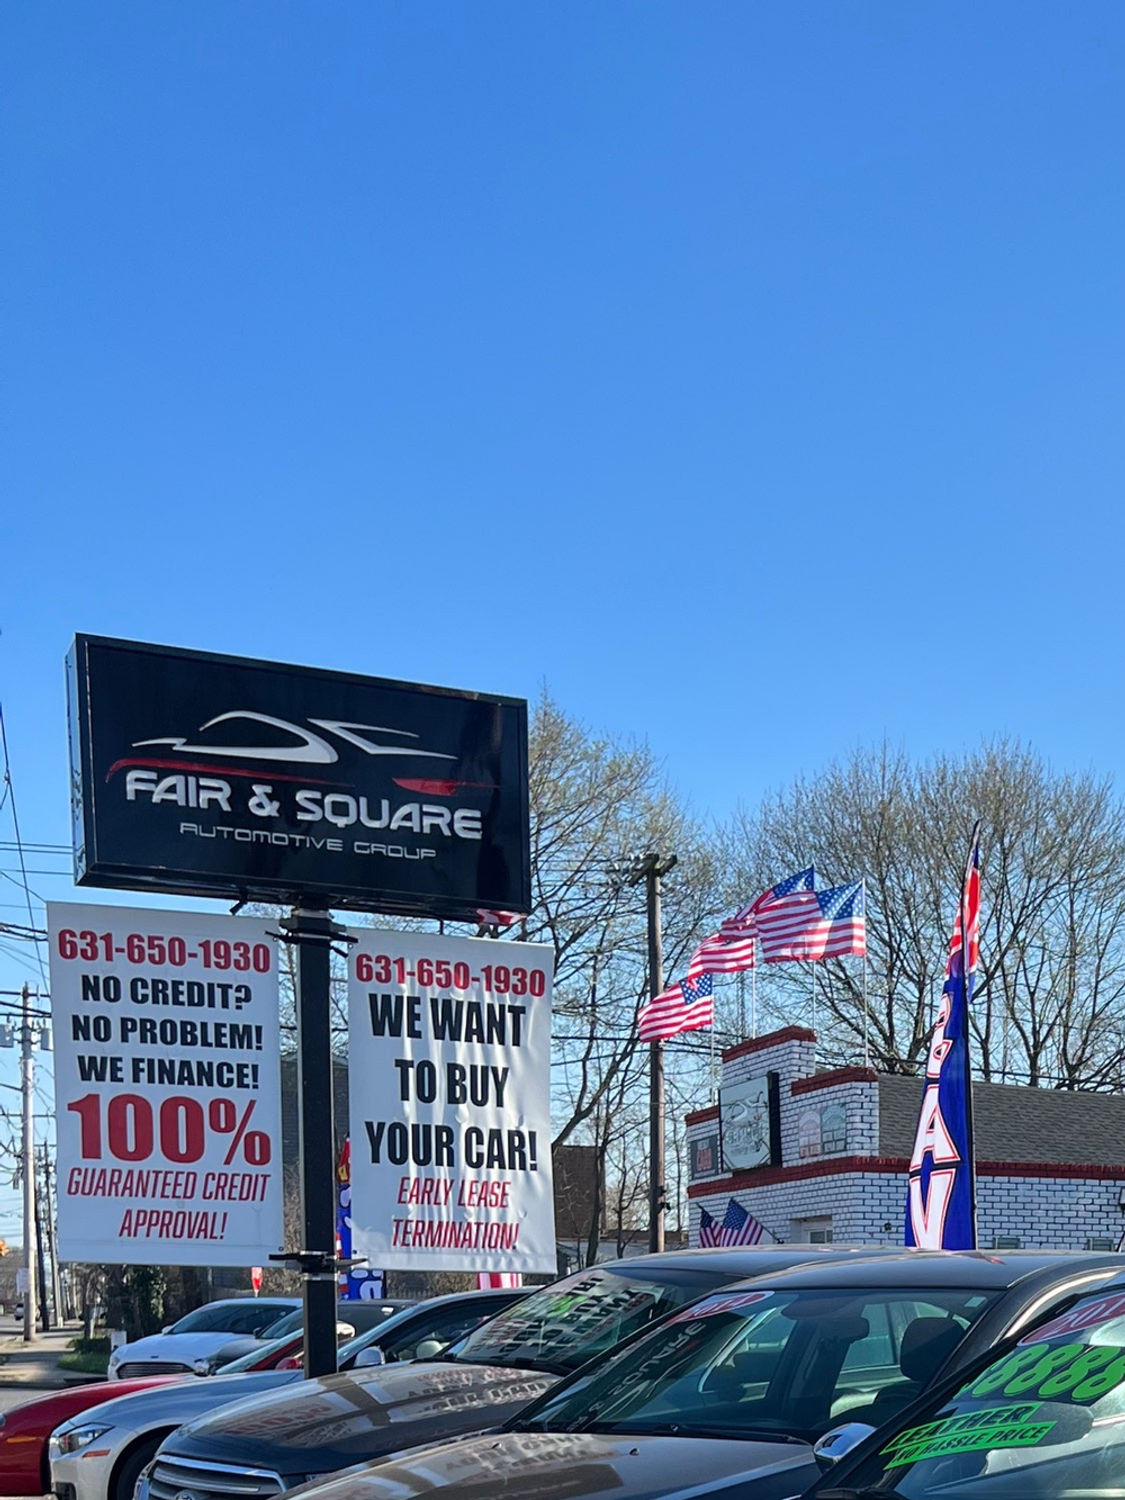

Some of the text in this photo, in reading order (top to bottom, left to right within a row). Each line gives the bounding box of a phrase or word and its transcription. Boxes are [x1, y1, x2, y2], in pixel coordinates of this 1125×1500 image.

[126, 769, 482, 840] FAIR & SQUARE
[180, 822, 436, 860] AUTOMOTIVE GROUP
[58, 928, 271, 974] 631-650-1930
[81, 974, 252, 1010] NO CREDIT?
[355, 953, 546, 997] 631-650-1930
[71, 1014, 263, 1050] NO PROBLEM!
[369, 993, 526, 1047] WE WANT
[77, 1055, 259, 1089] WE FINANCE!
[395, 1059, 510, 1108] TO BUY
[67, 1093, 272, 1166] 100%
[365, 1121, 538, 1172] YOUR CAR!
[67, 1167, 272, 1202] GUARANTEED CREDIT
[397, 1176, 512, 1208] EARLY LEASE
[119, 1209, 228, 1240] APPROVAL!
[392, 1218, 520, 1250] TERMINATION!
[986, 1425, 1049, 1444] PRICE
